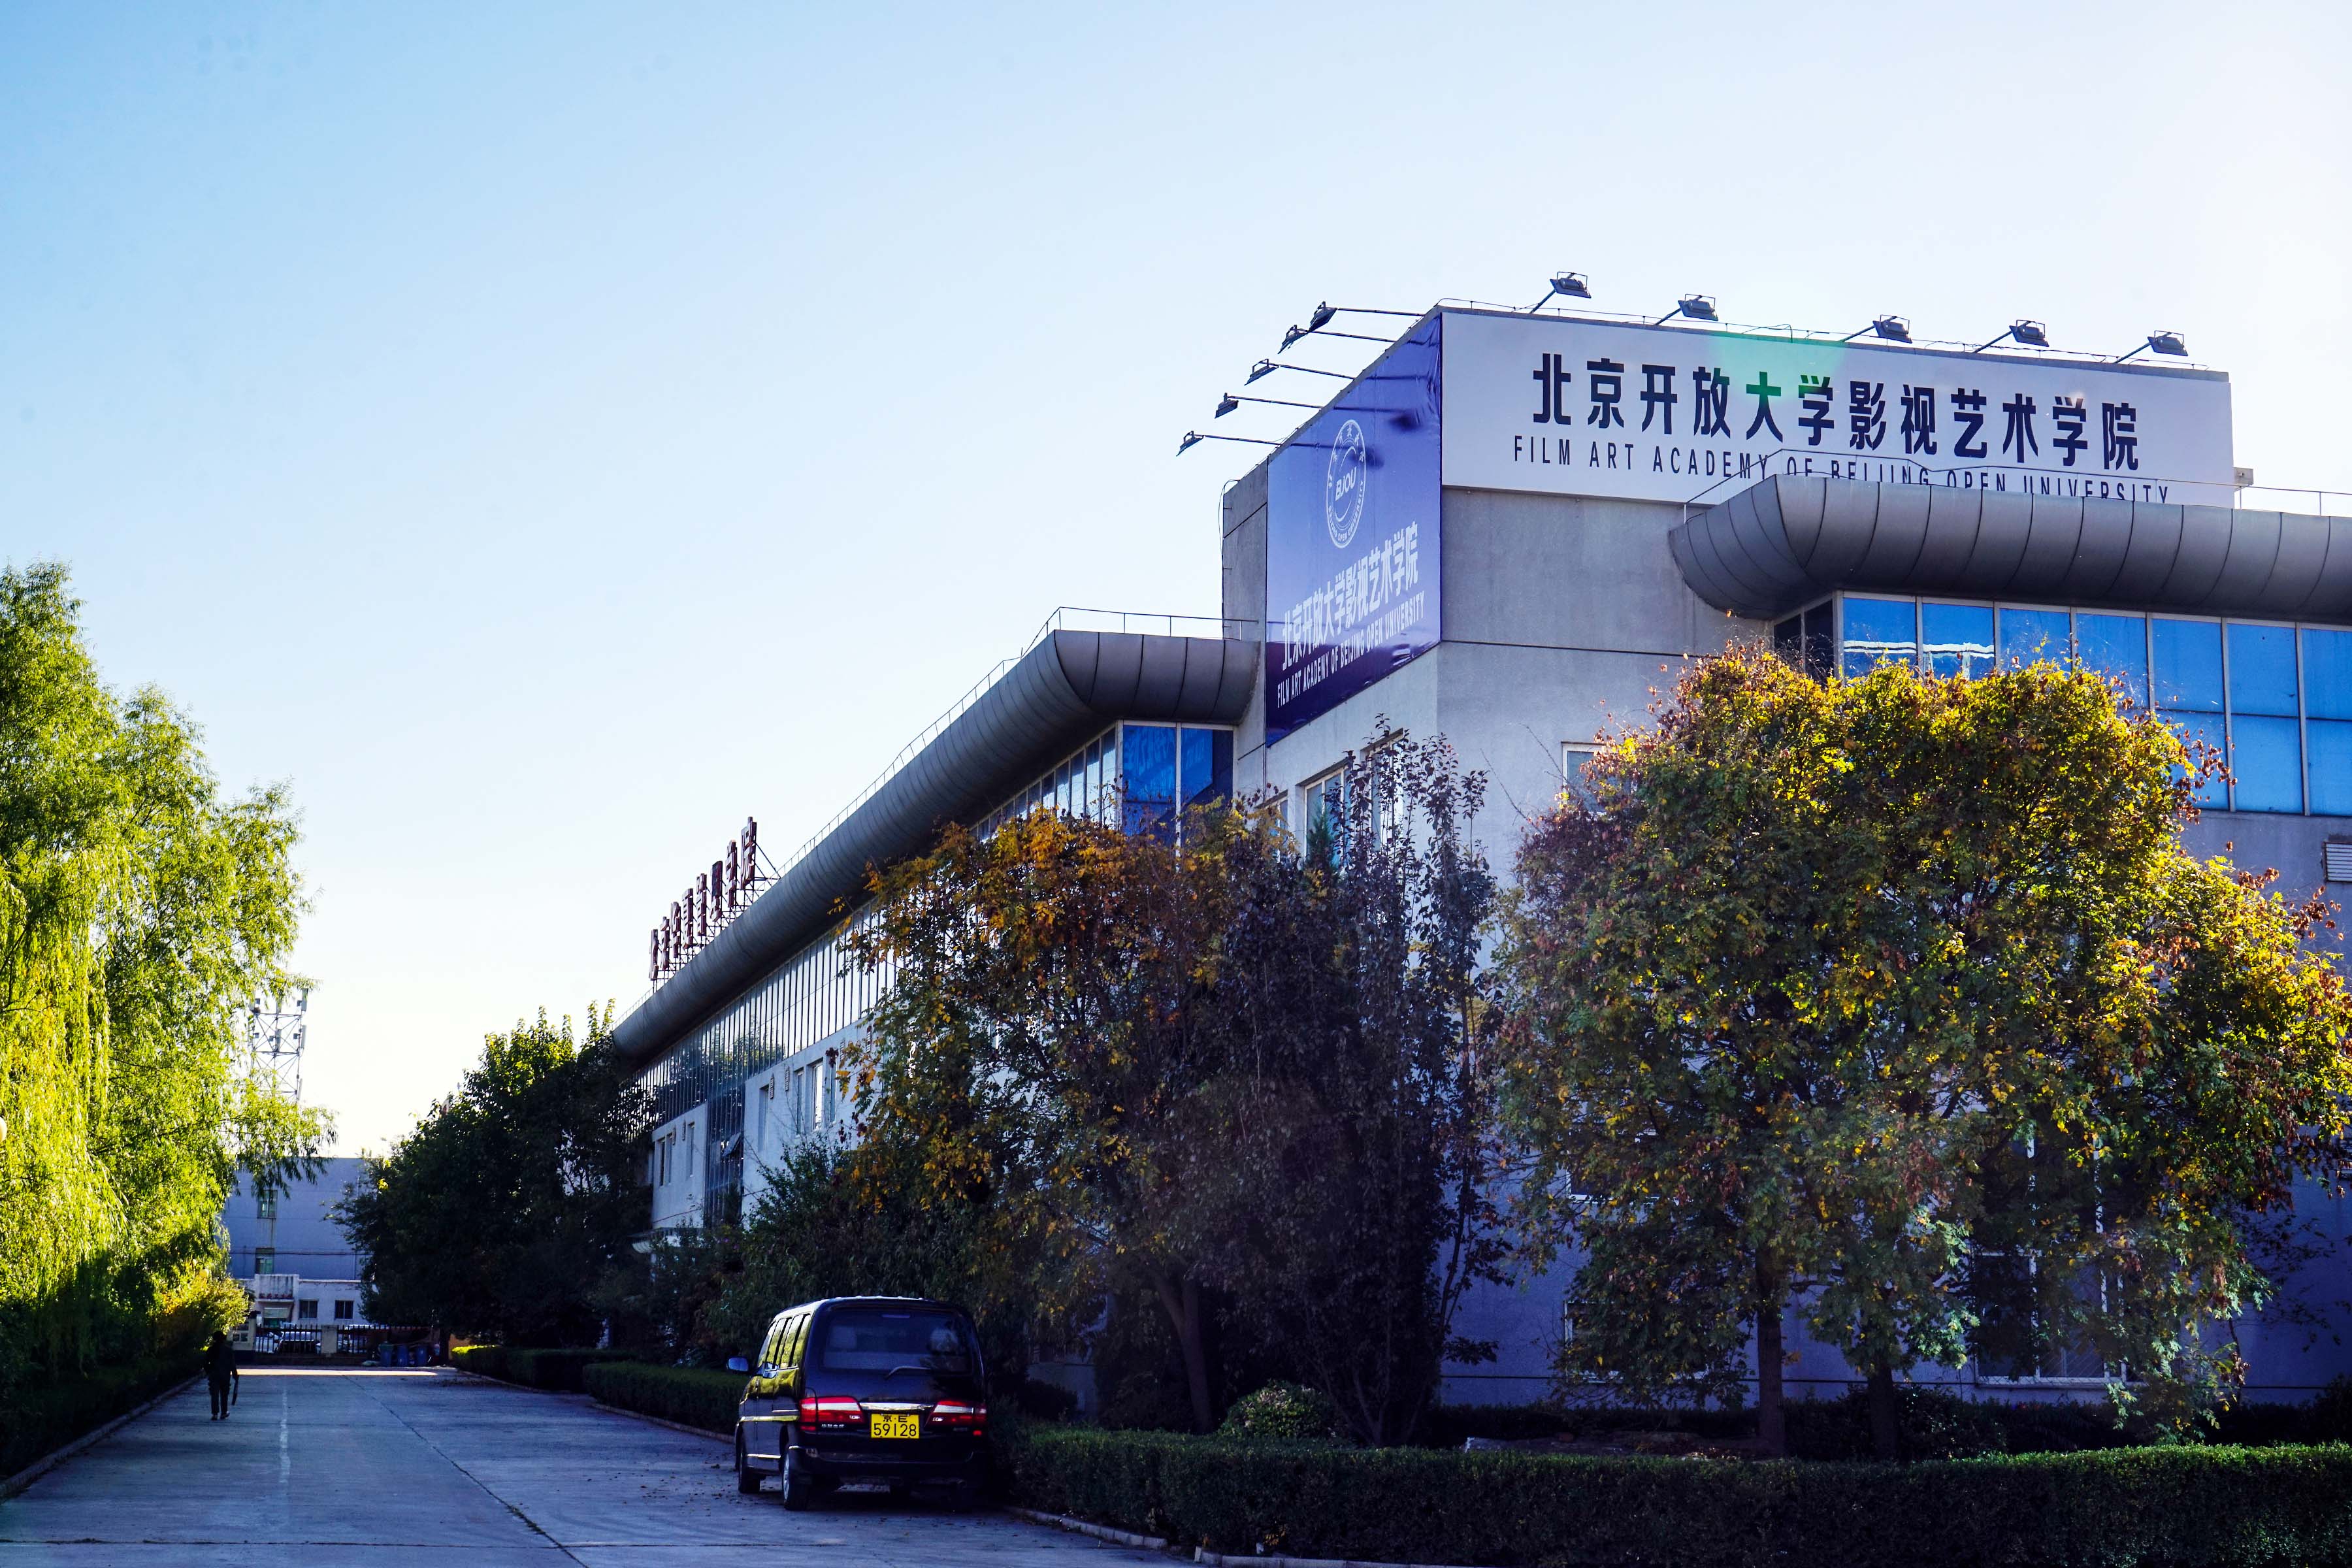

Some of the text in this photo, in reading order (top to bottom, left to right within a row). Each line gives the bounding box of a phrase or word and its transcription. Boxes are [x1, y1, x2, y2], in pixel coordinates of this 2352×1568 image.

[1532, 353, 2139, 471] 北京开放大学影视艺术学院
[1335, 466, 1357, 502] BJOU
[1514, 435, 2168, 504] FILM ART ACADEMY OF BEIJING OPEN UNIVERSITY
[1282, 521, 1418, 671] 北京开放大学影视艺术学院
[1277, 590, 1425, 709] FILM ART ACADEMY OF BEIJING OPEN UNIVERSITY
[874, 1423, 917, 1437] 59128
